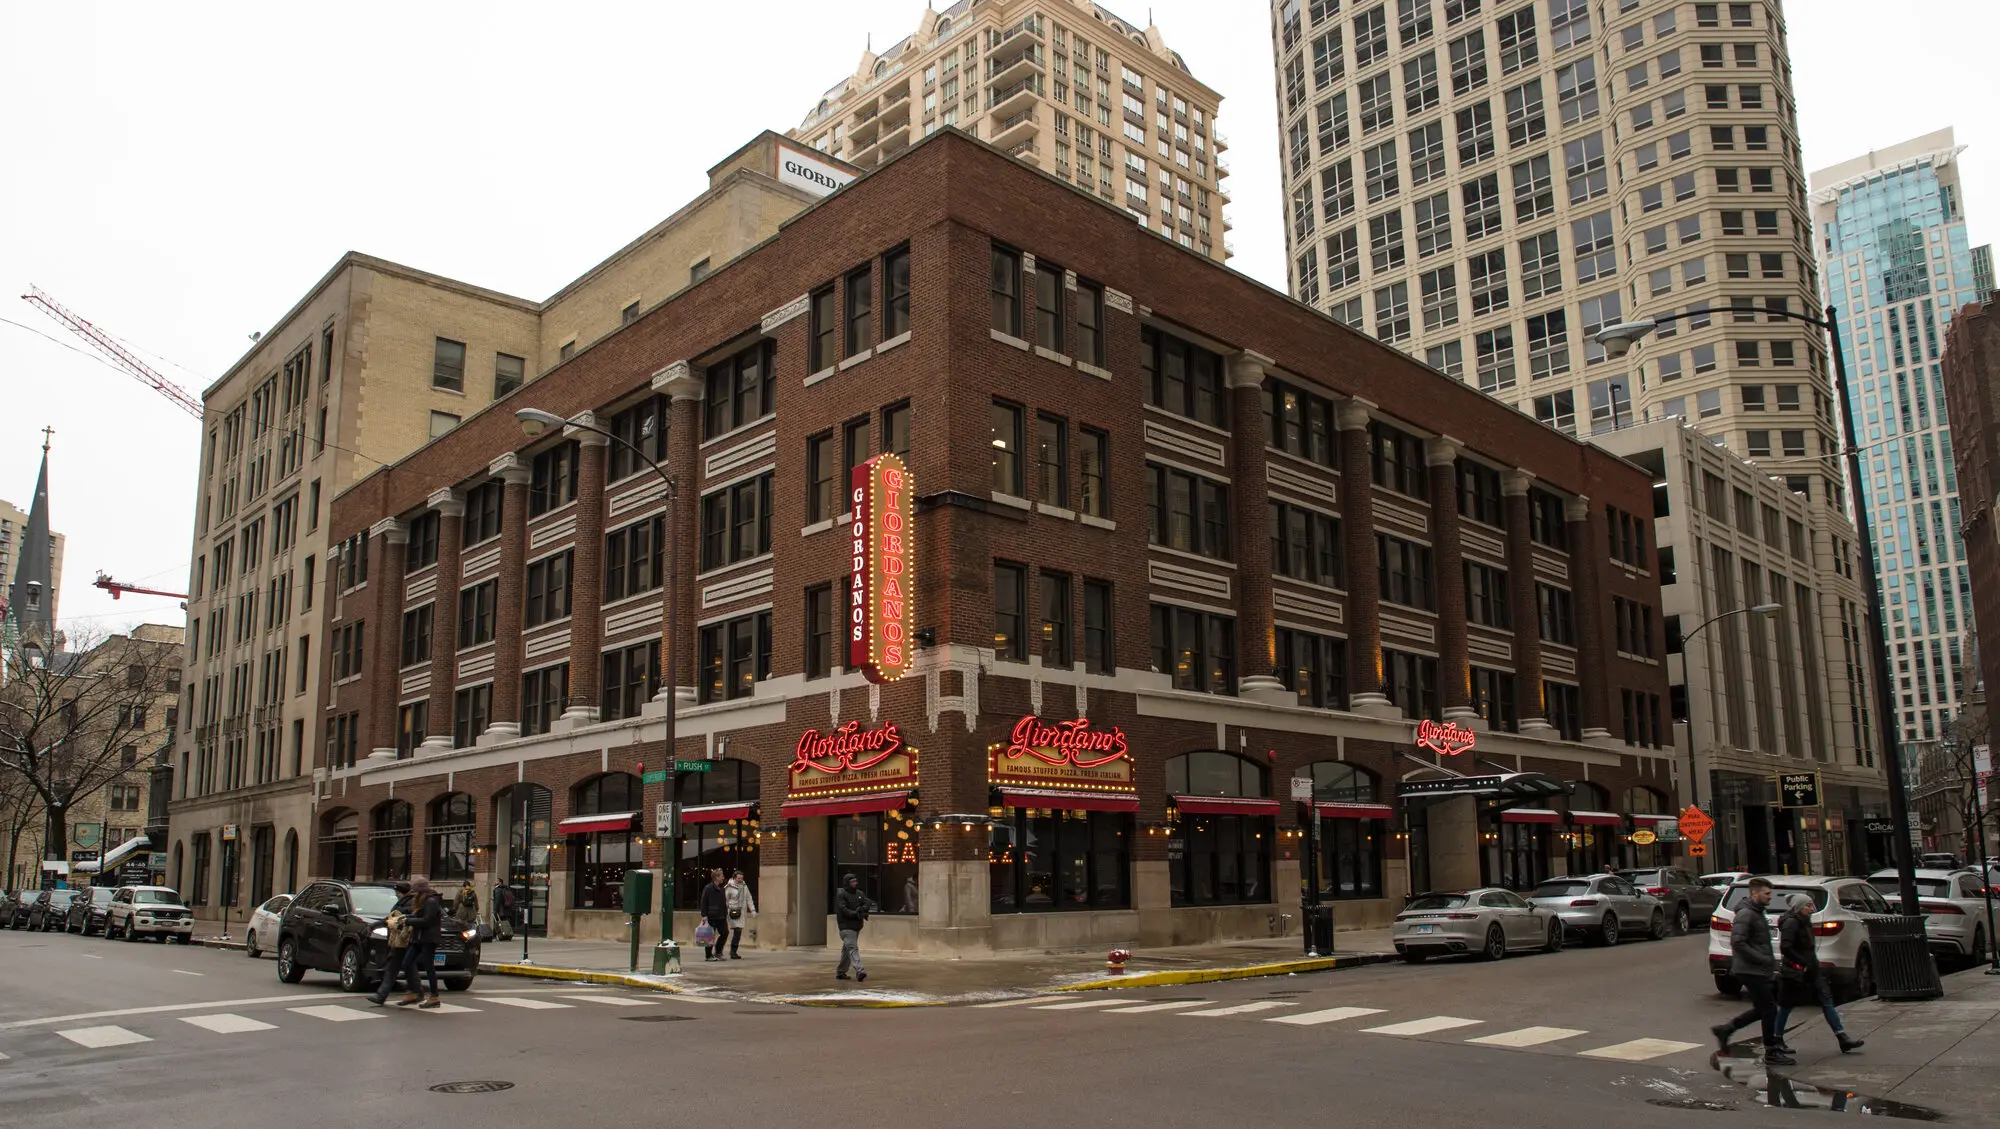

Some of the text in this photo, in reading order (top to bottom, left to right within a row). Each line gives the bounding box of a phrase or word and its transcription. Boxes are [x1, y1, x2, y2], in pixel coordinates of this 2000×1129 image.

[1006, 715, 1127, 768] Giordano's
[1417, 719, 1476, 756] Giordano's
[793, 720, 902, 774] Giordano's
[683, 762, 703, 771] RUSH
[1006, 764, 1031, 774] FAMOUS
[1033, 766, 1059, 776] STUFFED
[798, 777, 819, 786] FAMOUS
[820, 775, 840, 785] STUFFED
[861, 771, 878, 780] FRESH
[1786, 775, 1809, 783] Public
[1784, 783, 1813, 791] Parking
[658, 805, 670, 814] ONE
[888, 842, 920, 863] EA
